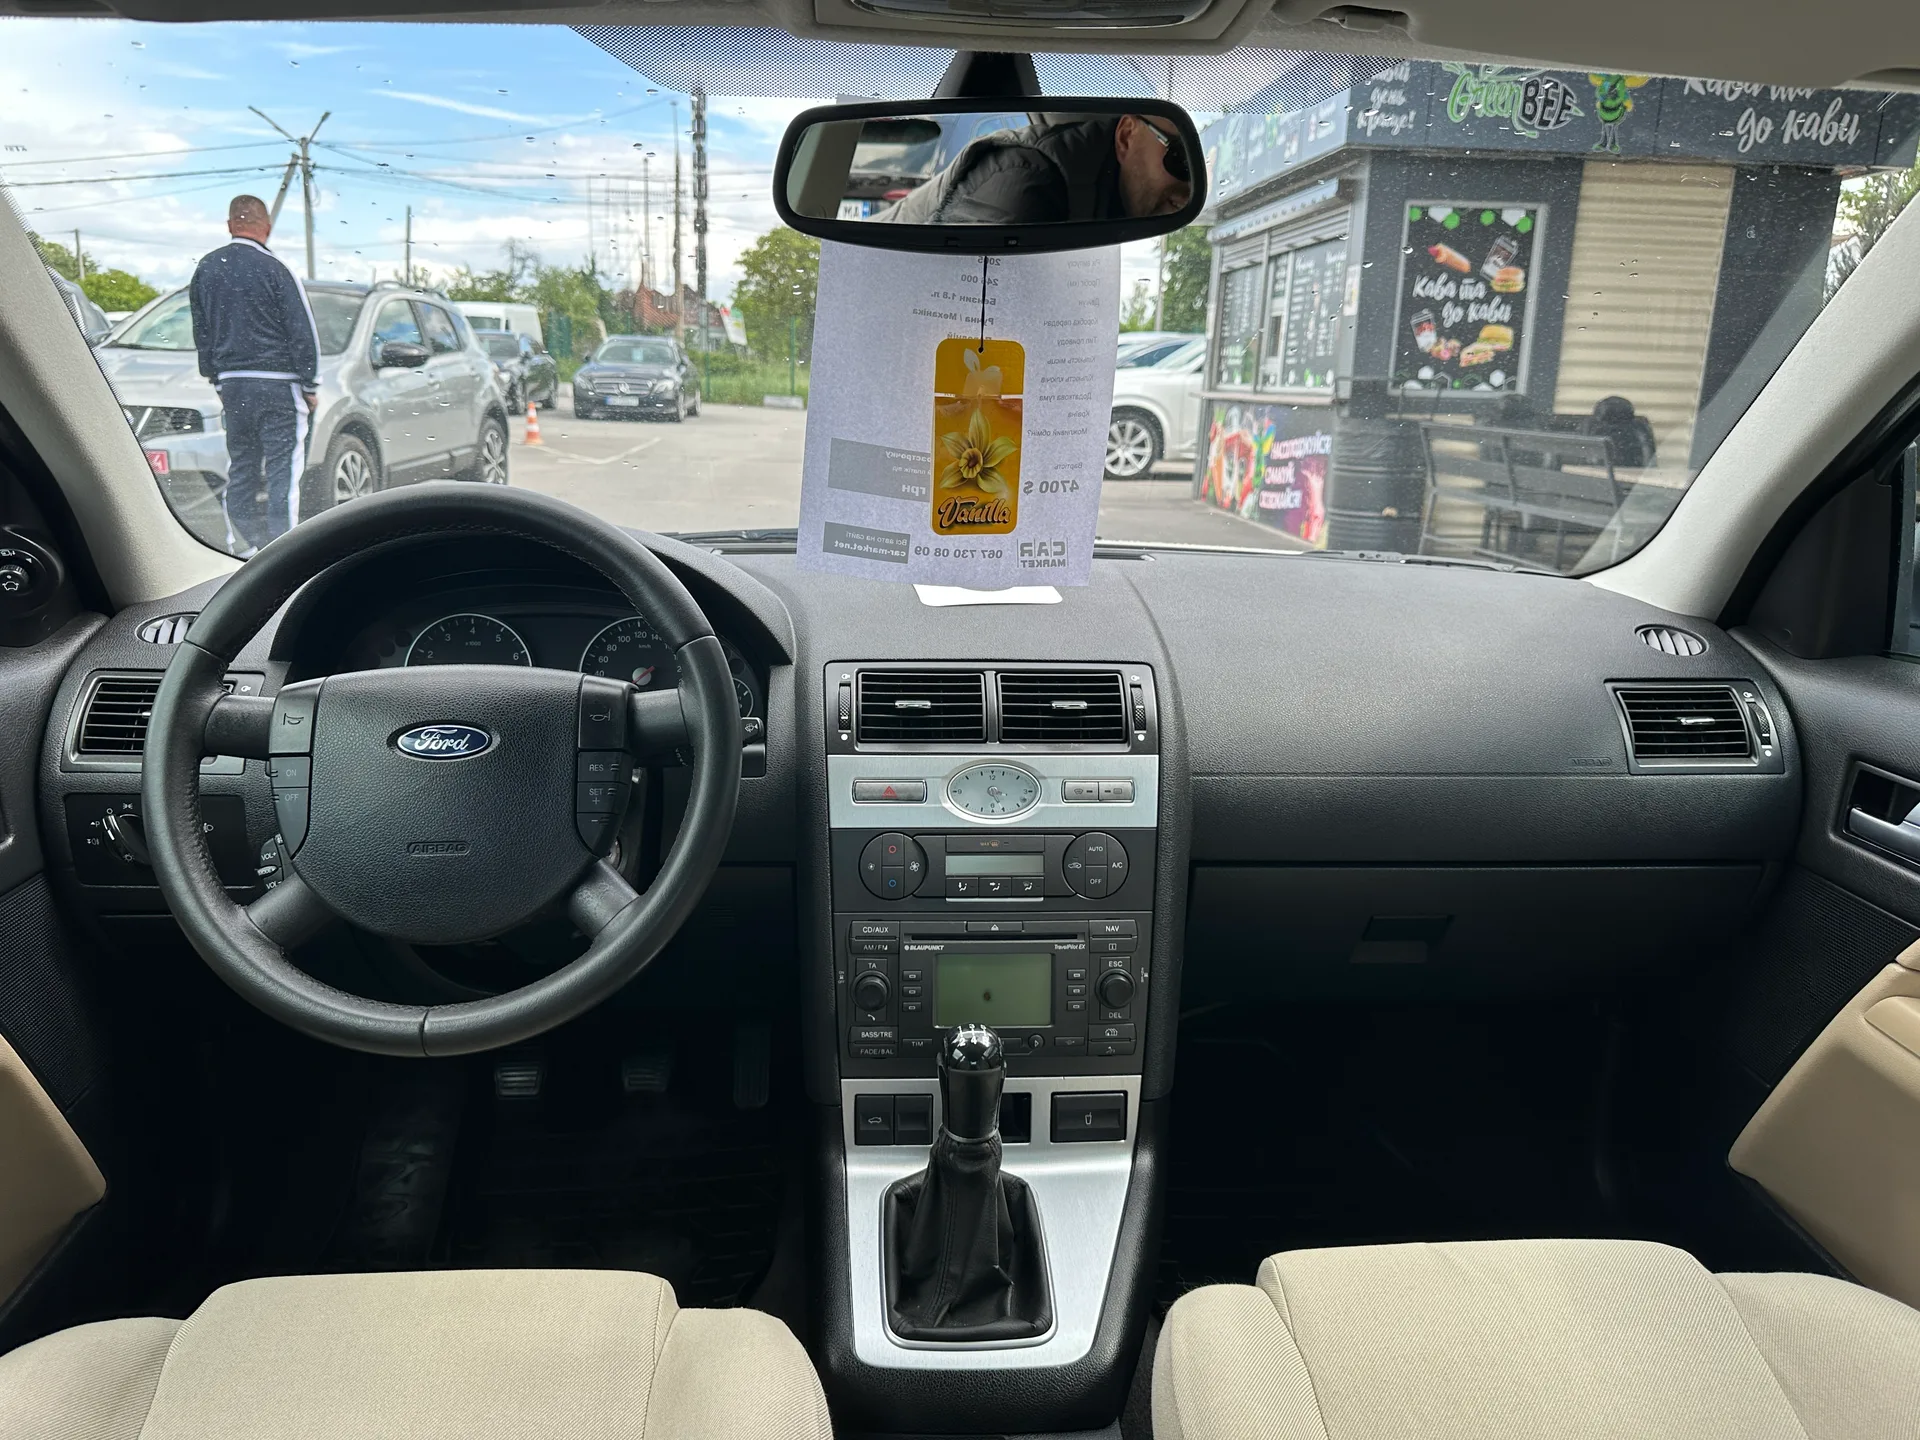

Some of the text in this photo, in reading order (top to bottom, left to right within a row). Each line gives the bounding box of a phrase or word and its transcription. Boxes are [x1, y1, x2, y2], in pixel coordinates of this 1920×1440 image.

[1736, 97, 1861, 153] до кави
[1412, 272, 1487, 301] Кава та
[1442, 295, 1513, 328] до кави
[938, 496, 1011, 528] Vanilla
[445, 633, 451, 641] 3
[495, 634, 501, 642] 5
[617, 635, 631, 643] 100
[634, 631, 648, 639] 120
[606, 644, 617, 652] 80
[427, 650, 434, 658] 2
[513, 652, 519, 660] 6
[414, 728, 471, 751] Ford
[285, 769, 297, 777] ON
[284, 793, 299, 801] OFF
[411, 843, 467, 853] AIRBAG
[261, 851, 277, 861] VOL+
[1111, 861, 1123, 869] A/C
[1108, 1011, 1122, 1019] DEL
